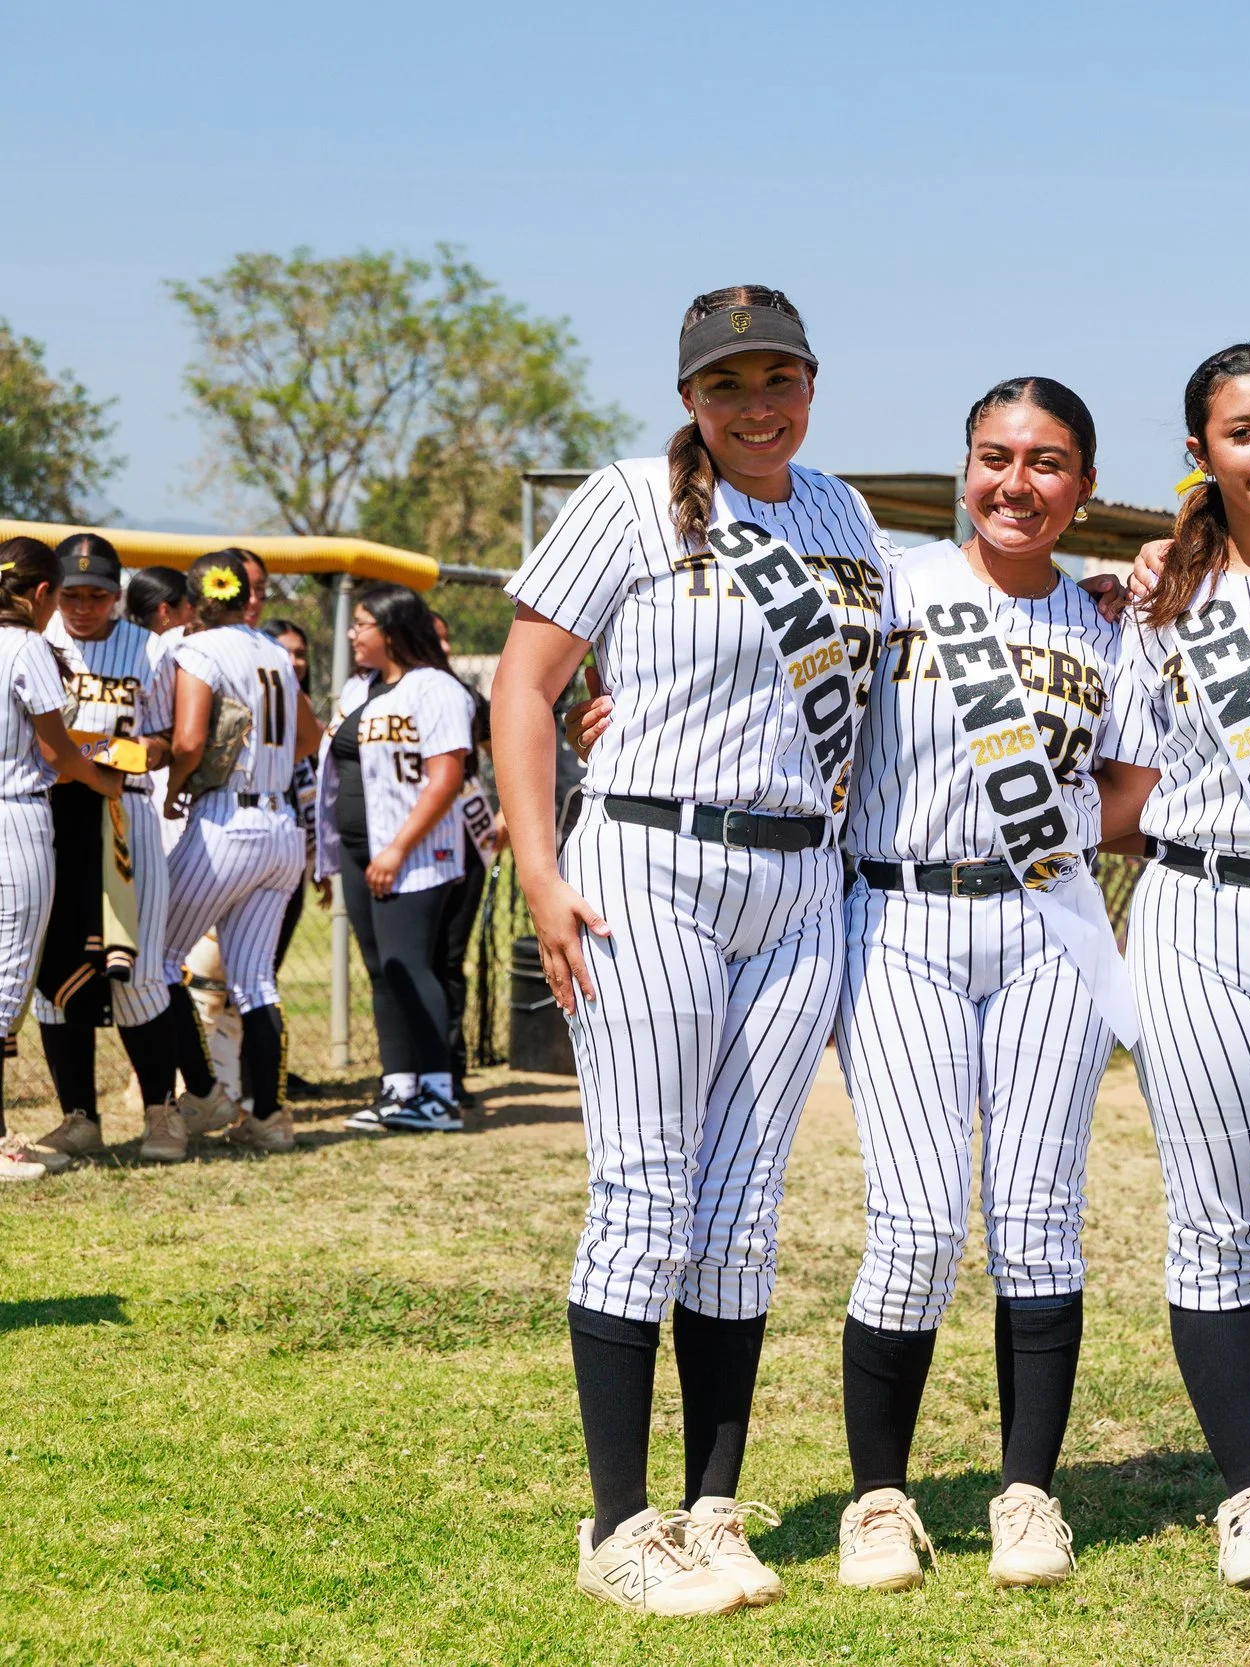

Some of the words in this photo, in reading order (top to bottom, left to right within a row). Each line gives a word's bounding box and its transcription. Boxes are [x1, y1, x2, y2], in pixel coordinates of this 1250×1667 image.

[673, 553, 884, 617] TERS
[788, 641, 844, 689] 2026
[886, 629, 1104, 718] TERS
[925, 602, 1026, 733] SEN
[257, 668, 286, 747] 11
[394, 750, 423, 784] 13
[969, 724, 1036, 767] 2026
[463, 796, 491, 838] OR
[985, 760, 1068, 864] OR
